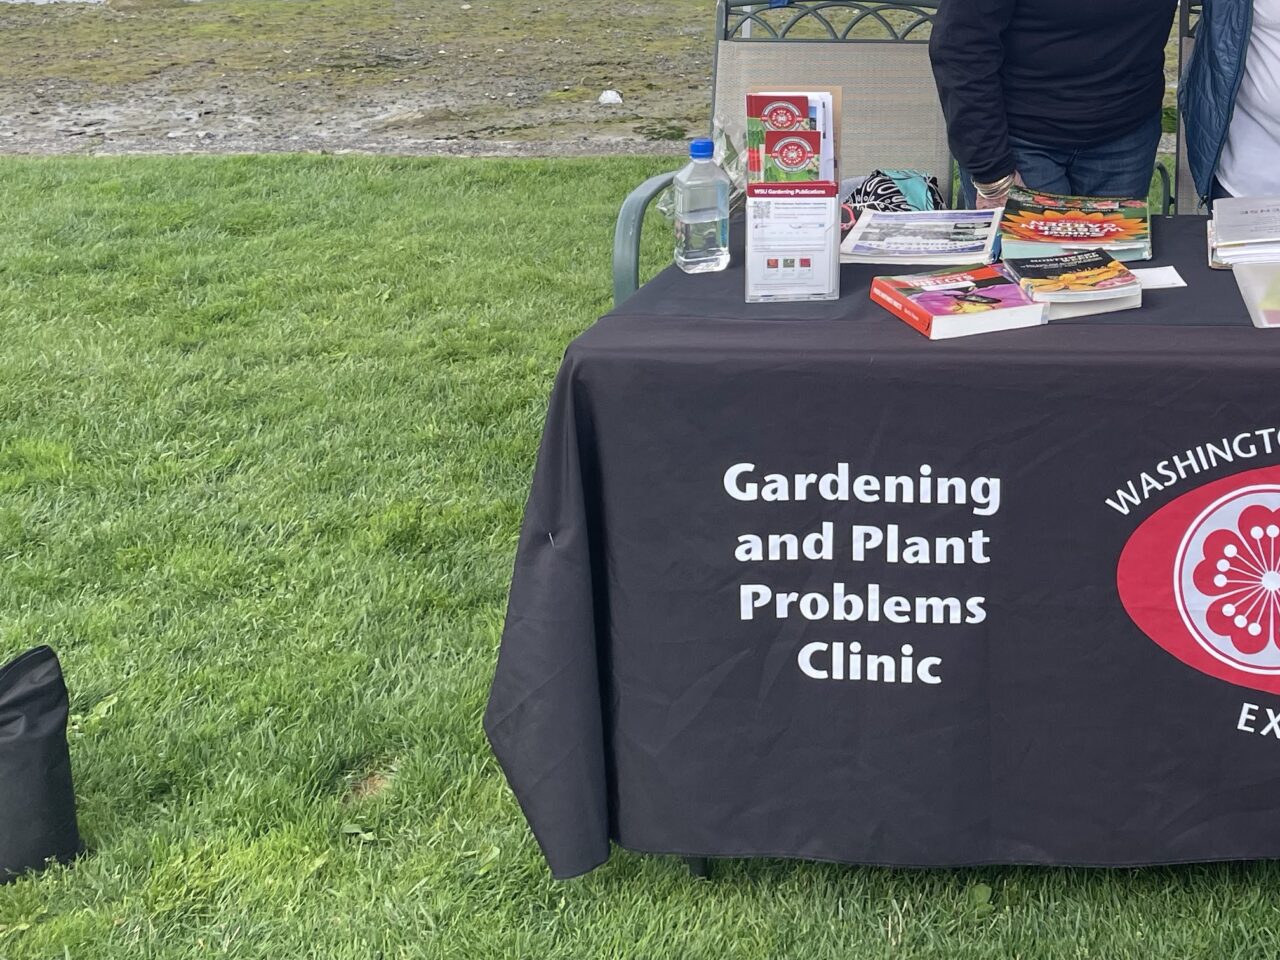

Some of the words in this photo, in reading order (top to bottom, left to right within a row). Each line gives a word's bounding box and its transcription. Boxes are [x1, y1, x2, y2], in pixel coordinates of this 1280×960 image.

[1030, 220, 1117, 228] GARDEN
[723, 462, 1001, 516] Gardening
[734, 521, 834, 562] and
[852, 524, 991, 564] Plant
[740, 582, 987, 624] Problems
[797, 641, 942, 684] Clinic
